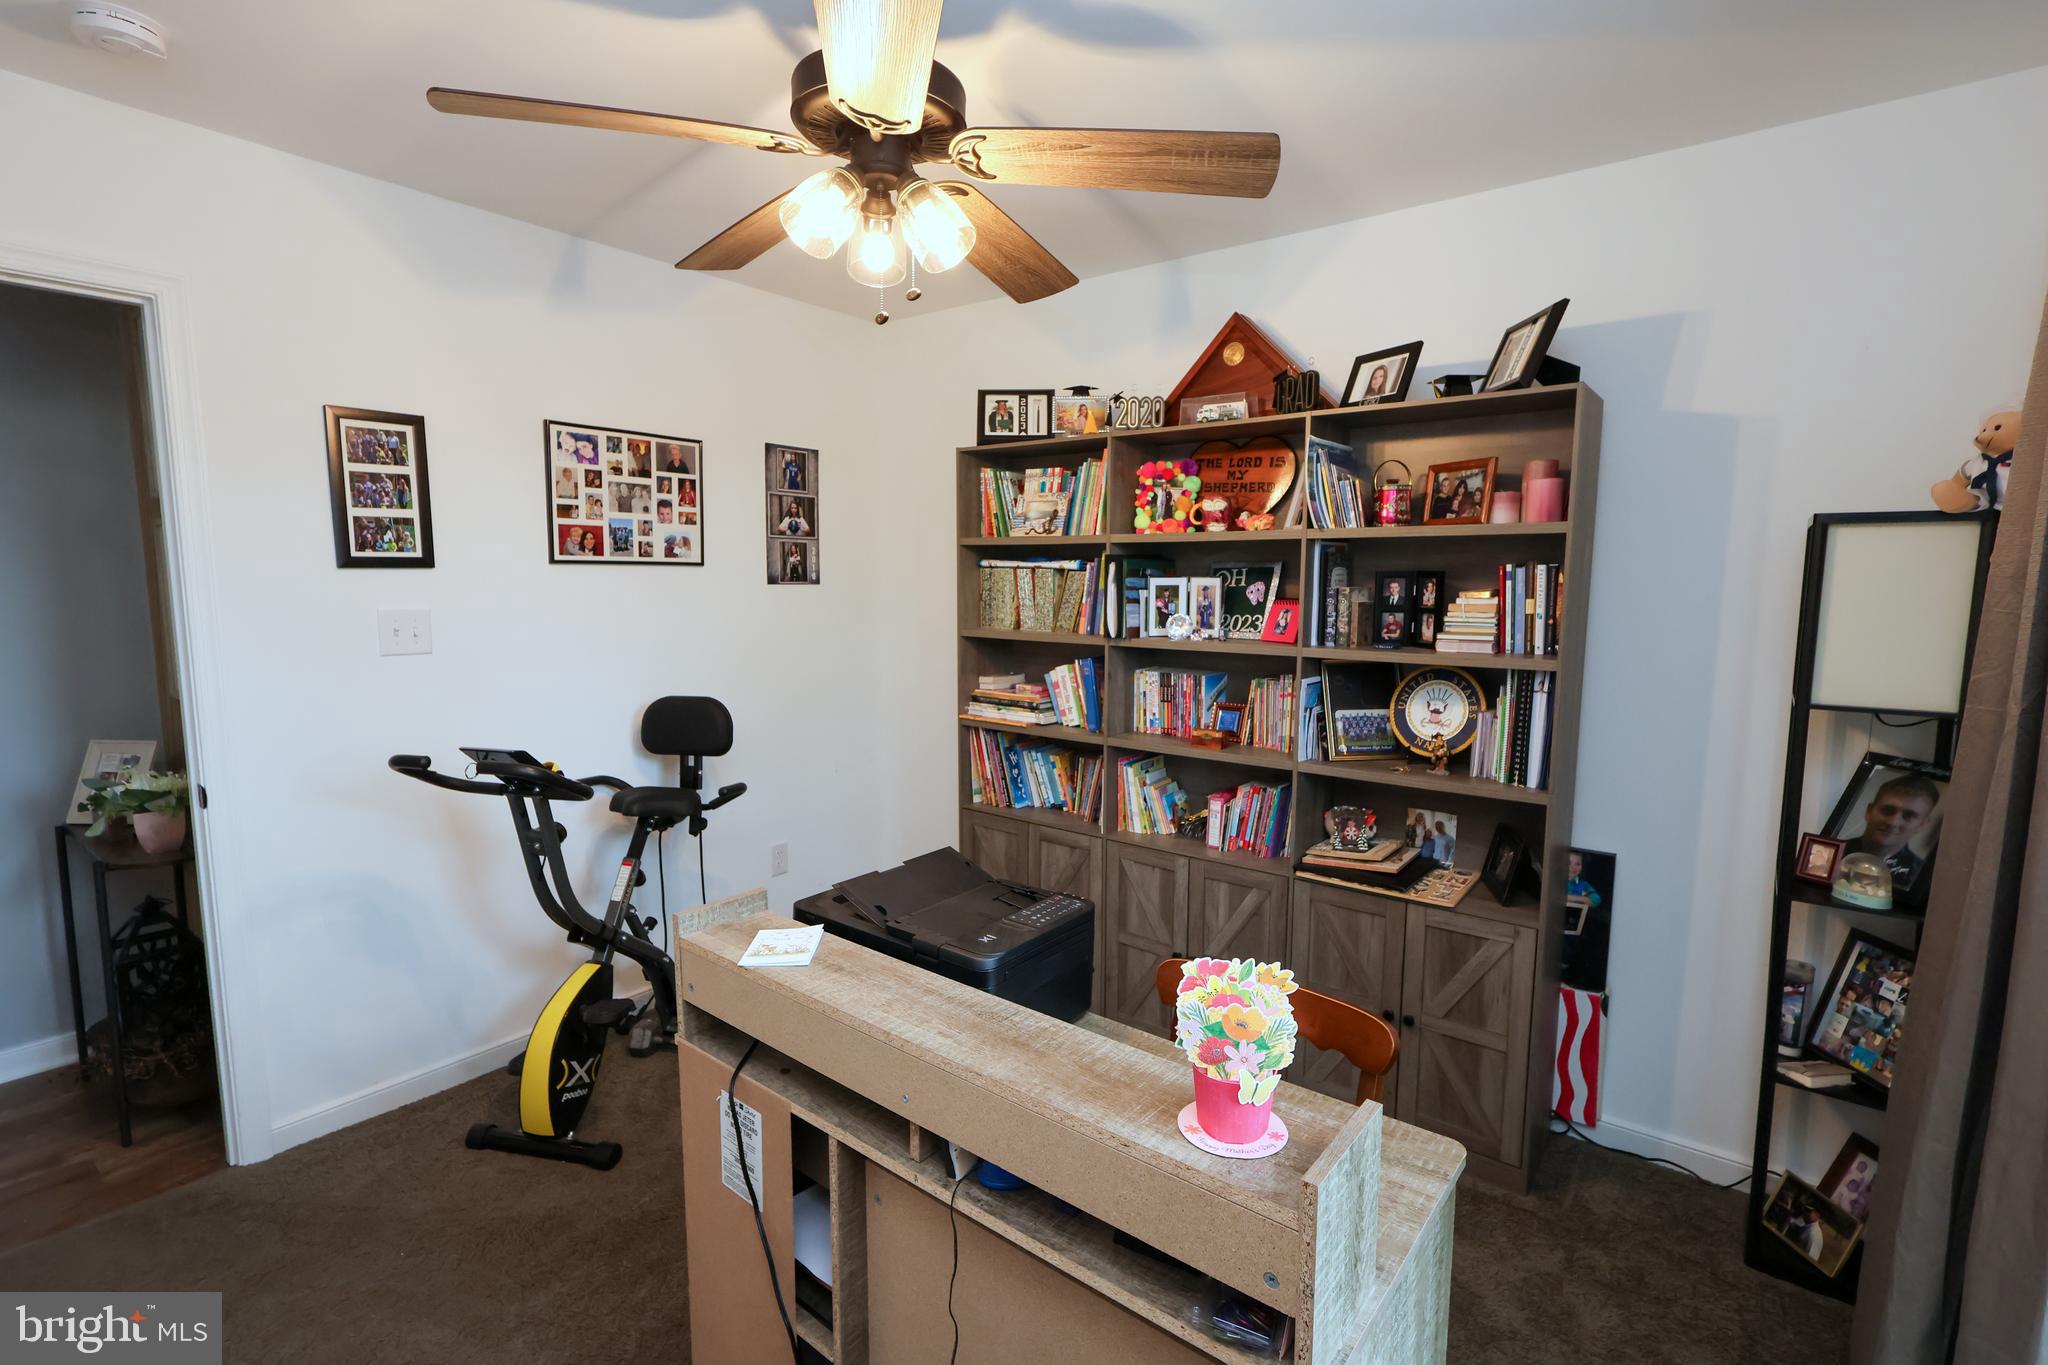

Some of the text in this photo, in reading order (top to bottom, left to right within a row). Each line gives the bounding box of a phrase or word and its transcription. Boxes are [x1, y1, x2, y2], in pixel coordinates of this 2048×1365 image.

[1115, 396, 1165, 428] 2020
[1197, 456, 1286, 468] THE LORD IS
[1227, 470, 1249, 480] MY
[1204, 481, 1276, 493] SHEPHERD
[1221, 614, 1263, 632] 2023
[1398, 672, 1478, 719] UNITED STATES
